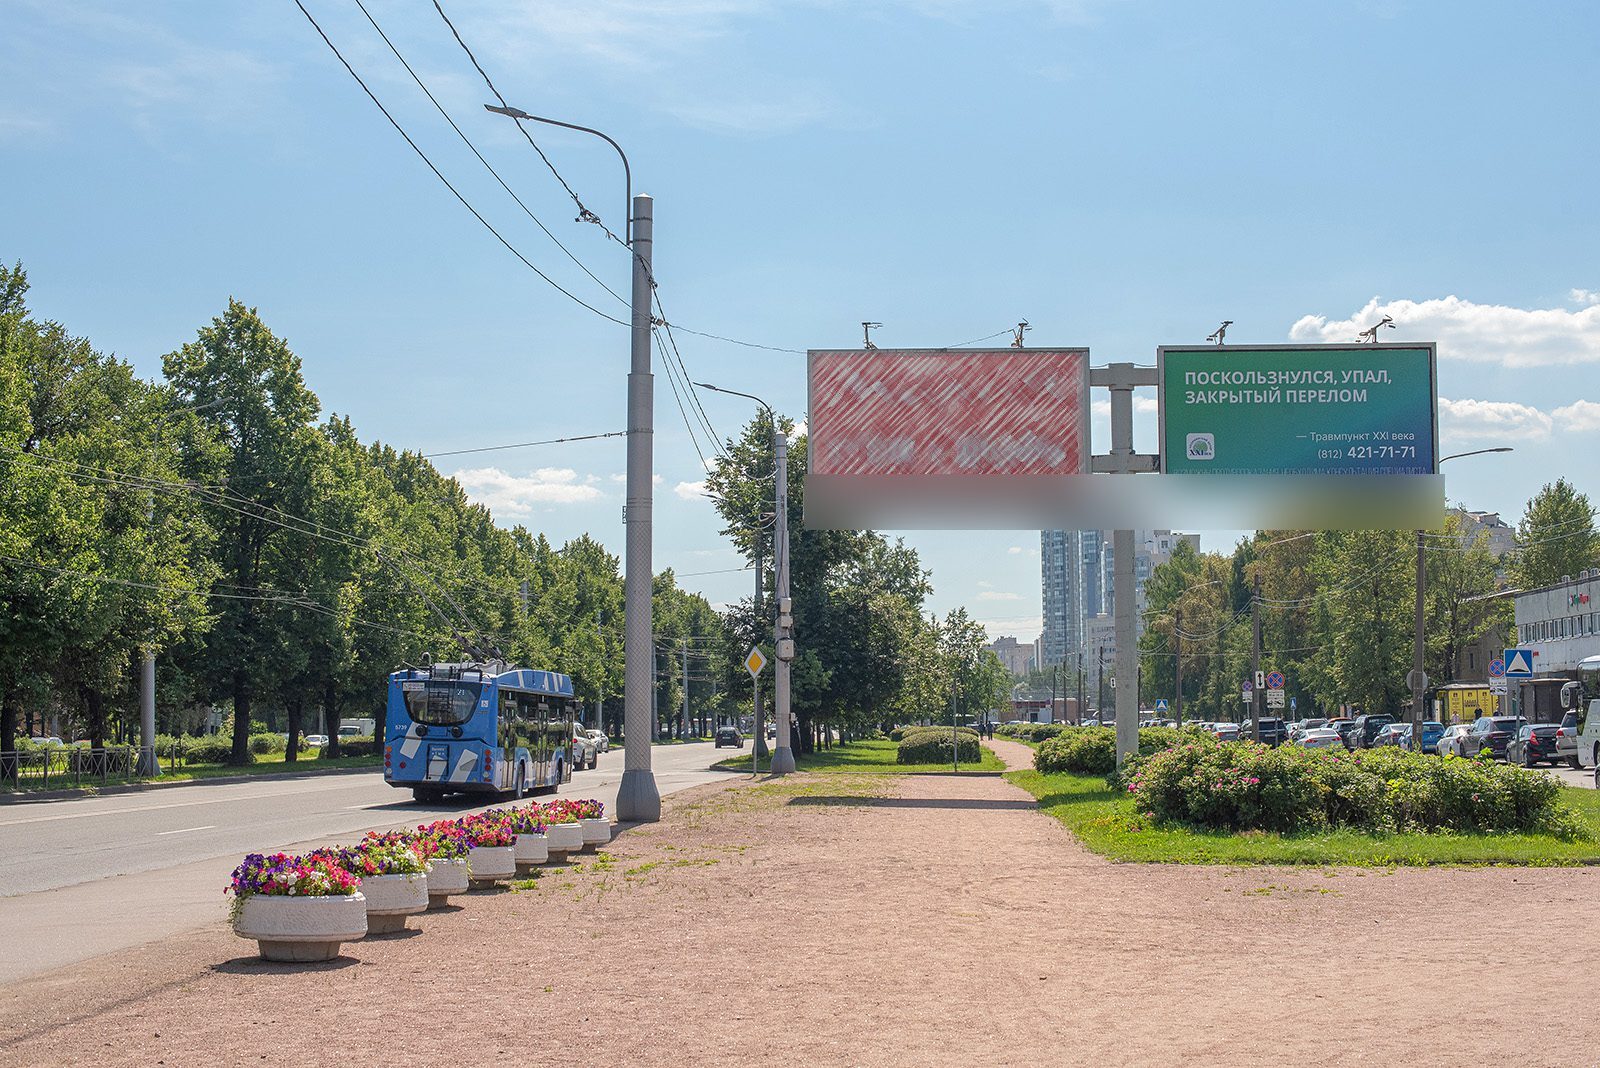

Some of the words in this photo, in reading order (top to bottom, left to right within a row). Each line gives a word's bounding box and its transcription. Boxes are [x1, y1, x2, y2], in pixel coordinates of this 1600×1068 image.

[1185, 371, 1338, 385] ПОСКОЛЬЗНУЛСЯ,
[1341, 370, 1392, 385] УПАЛ,
[1185, 387, 1280, 404] ЗАКРЫТЫЙ
[1286, 389, 1367, 402] ПЕРЕЛОМ
[1310, 431, 1370, 442] Травмпункт
[1373, 431, 1389, 440] XXI
[1392, 432, 1415, 440] века
[1318, 449, 1342, 459] (812)
[1347, 446, 1416, 458] 421-71-71
